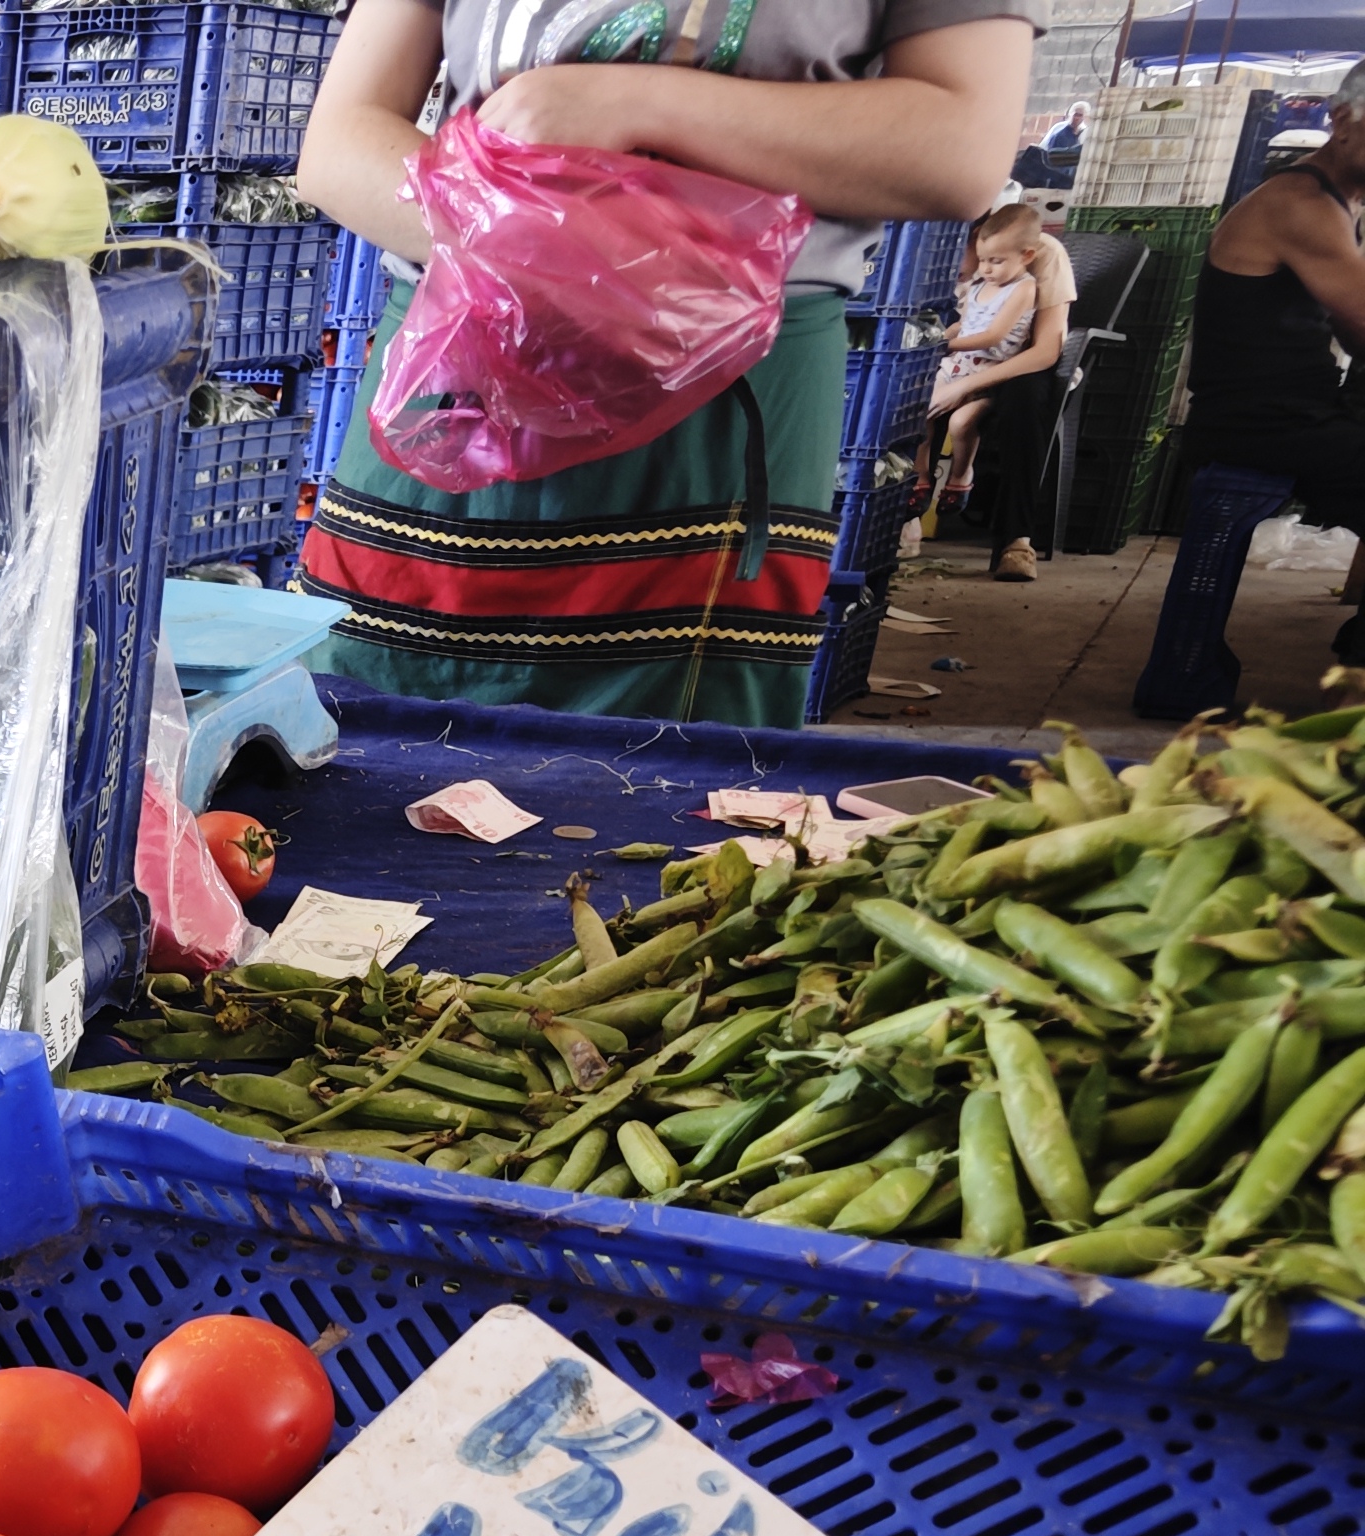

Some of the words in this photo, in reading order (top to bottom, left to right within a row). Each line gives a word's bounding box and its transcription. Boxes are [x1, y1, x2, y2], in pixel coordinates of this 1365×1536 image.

[118, 91, 167, 112] 143
[119, 453, 140, 606] 143
[472, 819, 499, 838] 10
